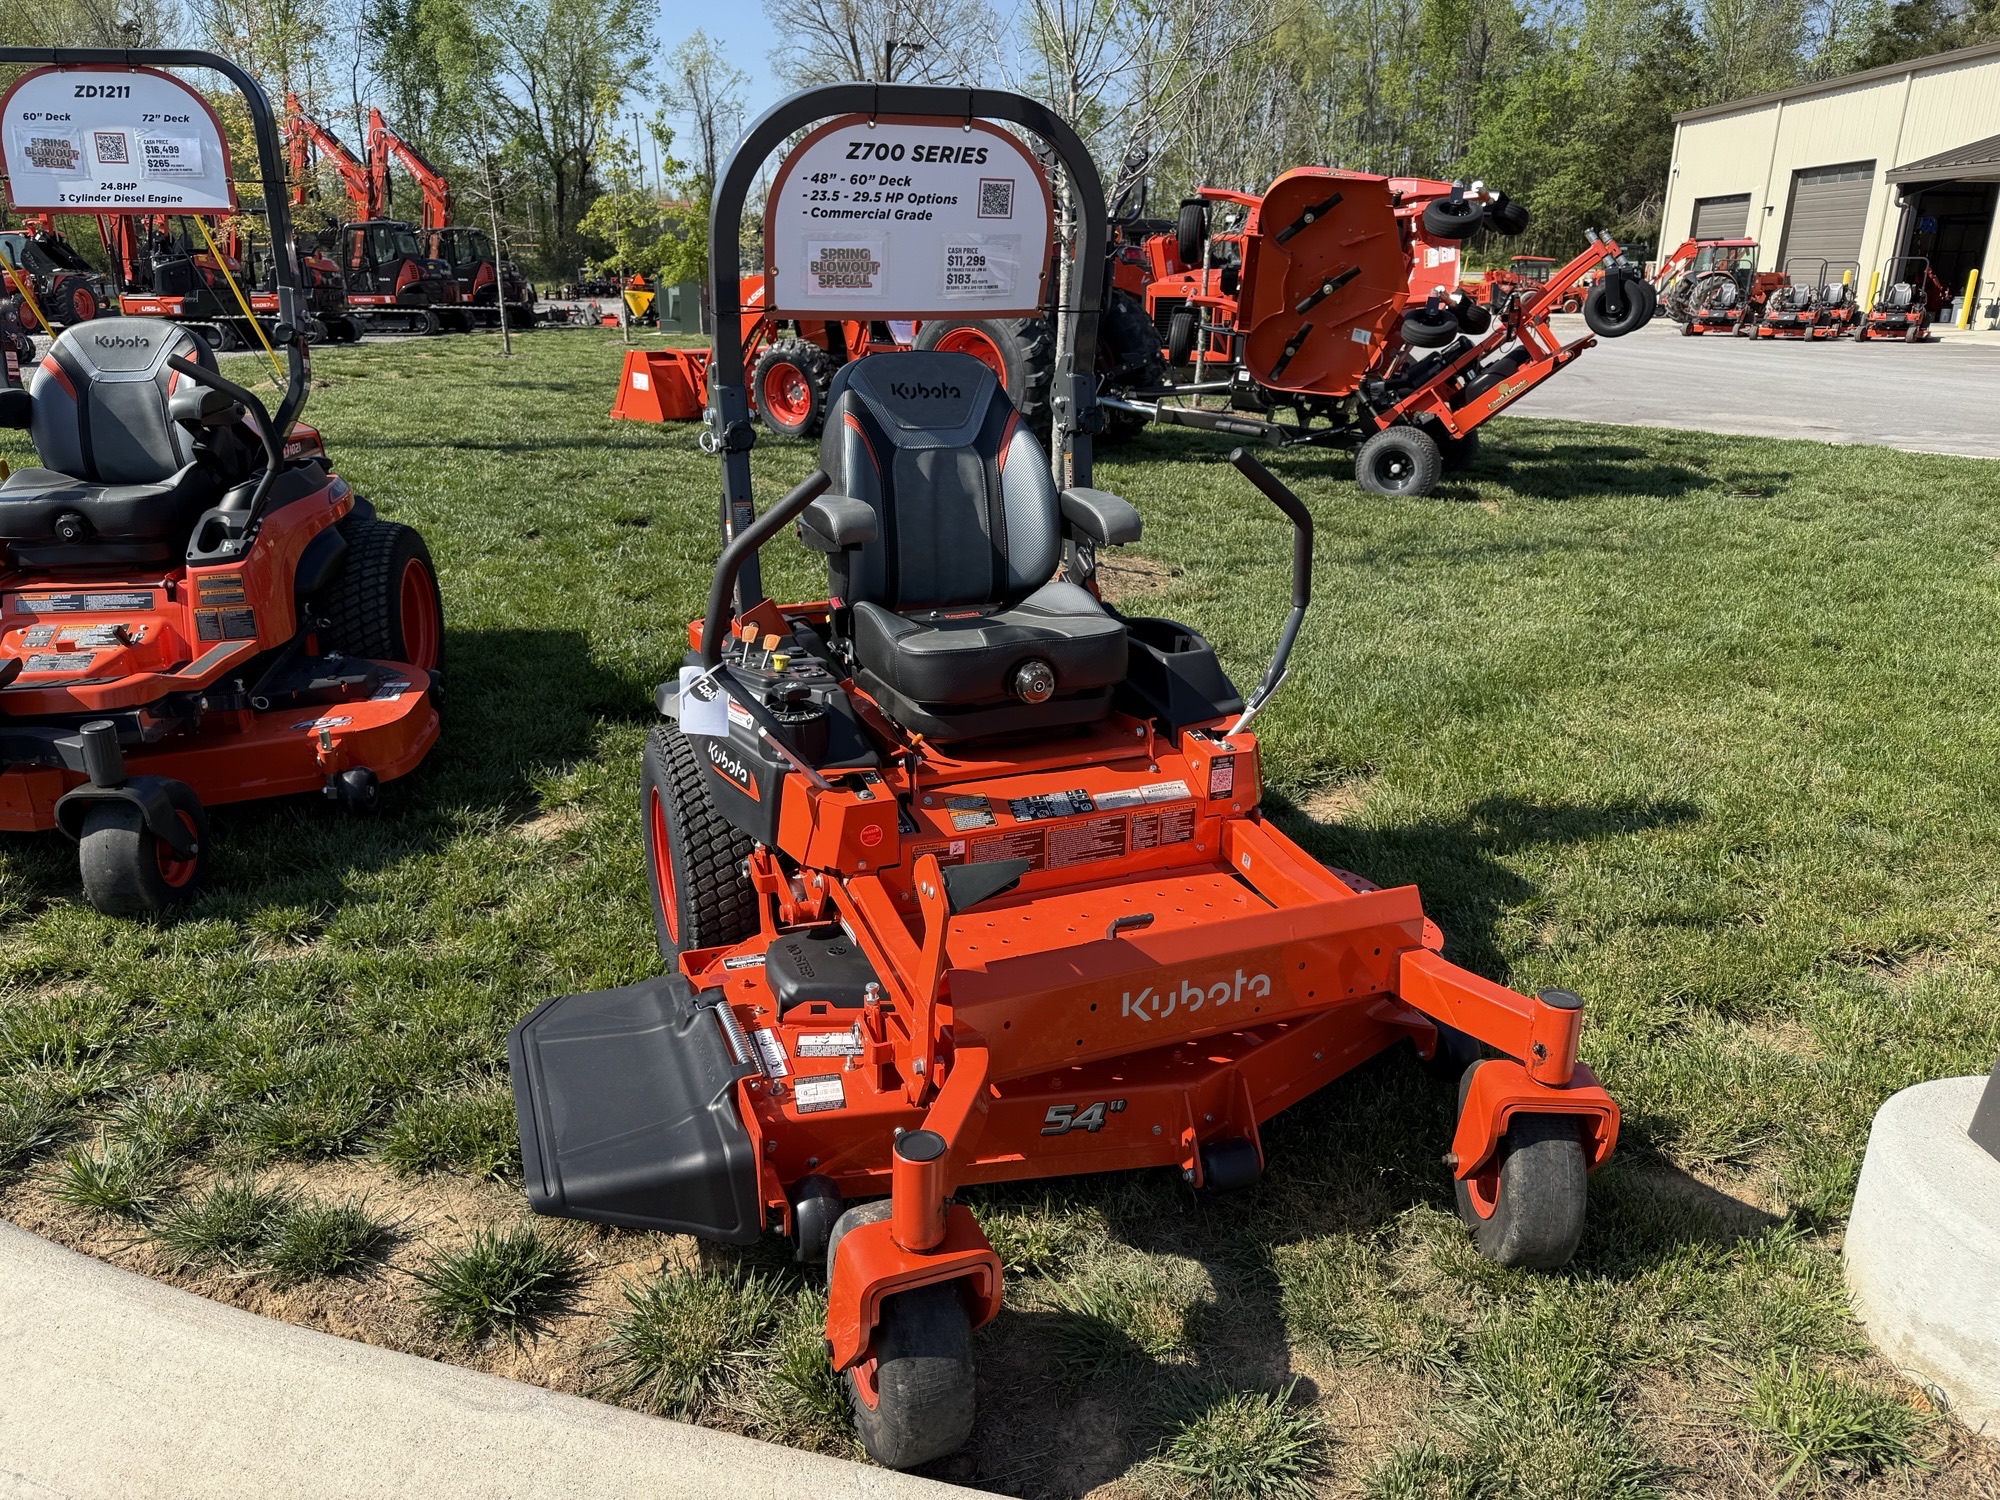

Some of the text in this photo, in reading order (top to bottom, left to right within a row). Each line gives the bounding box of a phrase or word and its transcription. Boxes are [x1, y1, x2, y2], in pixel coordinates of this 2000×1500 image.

[74, 85, 130, 98] ZD1211
[45, 113, 71, 122] Deck
[164, 114, 190, 123] Deck
[30, 137, 71, 149] SPRING
[145, 145, 180, 154] $16,499
[24, 147, 79, 160] BLOWOUT
[846, 142, 988, 165] Z700 SERIES
[32, 156, 75, 169] SPECIAL
[147, 159, 170, 168] $265
[399, 150, 416, 172] Kubota
[100, 182, 138, 191] 24.8HP
[878, 175, 912, 187] Deck
[59, 193, 183, 204] 3 Cylinder Diesel Engine
[810, 190, 840, 202] 23.5
[852, 191, 881, 203] 29.5
[884, 193, 904, 203] HP
[907, 193, 958, 206] Options
[810, 207, 891, 220] Commercial
[894, 209, 933, 221] Grade
[820, 248, 871, 262] SPRING
[947, 254, 986, 267] $11,299
[810, 261, 880, 275] BLOWOUT
[818, 274, 873, 288] SPECIAL
[946, 272, 971, 285] $183
[95, 335, 149, 348] Kubota
[890, 382, 961, 400] Kubota
[707, 741, 747, 782] Kubota
[1121, 969, 1271, 1021] Kubota
